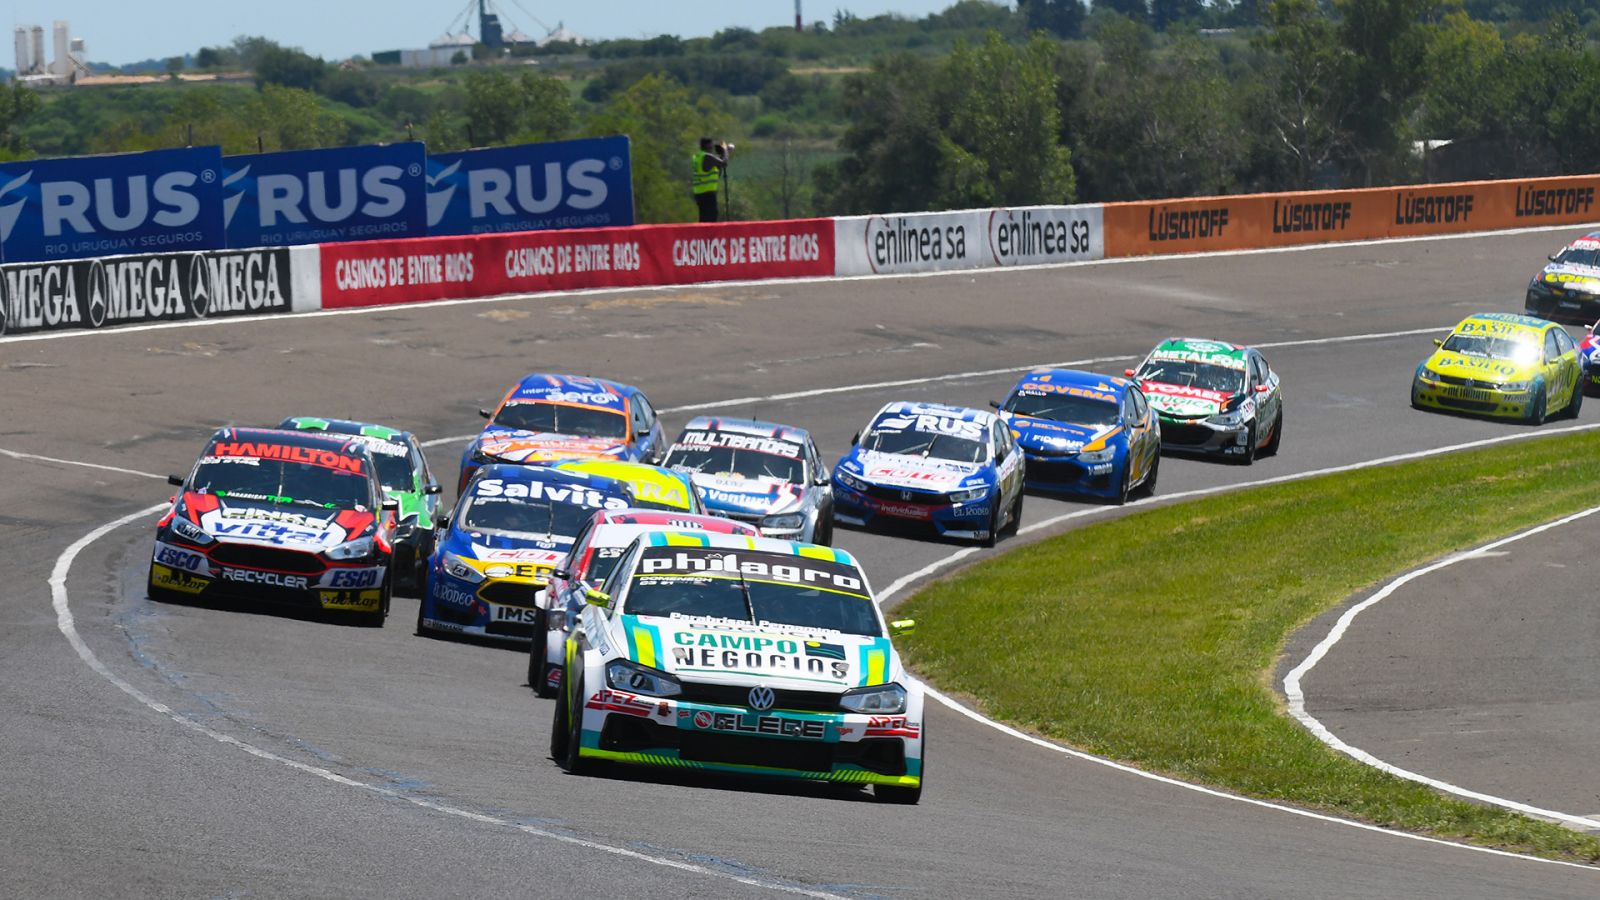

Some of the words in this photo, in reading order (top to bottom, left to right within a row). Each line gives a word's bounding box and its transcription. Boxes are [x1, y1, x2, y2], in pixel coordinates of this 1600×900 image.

[40, 170, 201, 236] RUS
[257, 165, 407, 228] RUS
[469, 159, 608, 219] RUS
[260, 233, 282, 244] RIO
[286, 226, 345, 242] URUGUAY
[350, 221, 408, 237] SEGUROS
[496, 218, 551, 233] URUGUAY
[555, 212, 611, 229] SEGUROS
[1071, 219, 1089, 255] sa
[45, 243, 69, 256] RIO
[72, 237, 137, 253] URUGUAY
[140, 231, 203, 247] SEGUROS
[672, 238, 727, 268] CASINOS
[729, 237, 746, 264] DE
[749, 235, 786, 263] ENTRE
[790, 233, 819, 262] RIOS
[946, 225, 965, 259] sa
[336, 256, 387, 291] CASINOS
[388, 256, 404, 286] DE
[408, 253, 442, 285] ENTRE
[445, 252, 475, 283] RIOS
[505, 246, 554, 279] CASINOS
[557, 244, 572, 274] DE
[575, 243, 610, 272] ENTRE
[613, 242, 640, 271] RIOS
[7, 265, 82, 328] MEGA
[106, 258, 186, 320] MEGA
[208, 252, 285, 314] MEGA
[1153, 350, 1245, 370] METALFOR
[1146, 381, 1224, 402] YOMEL
[215, 441, 362, 473] HAMILTON
[683, 432, 800, 458] MULTIBANDAS
[477, 479, 628, 511] Salvita
[158, 547, 203, 571] ESCO
[642, 552, 862, 590] philagro
[330, 570, 378, 587] ESCO
[674, 632, 798, 654] CAMPO
[673, 648, 849, 679] NEGOCIOS
